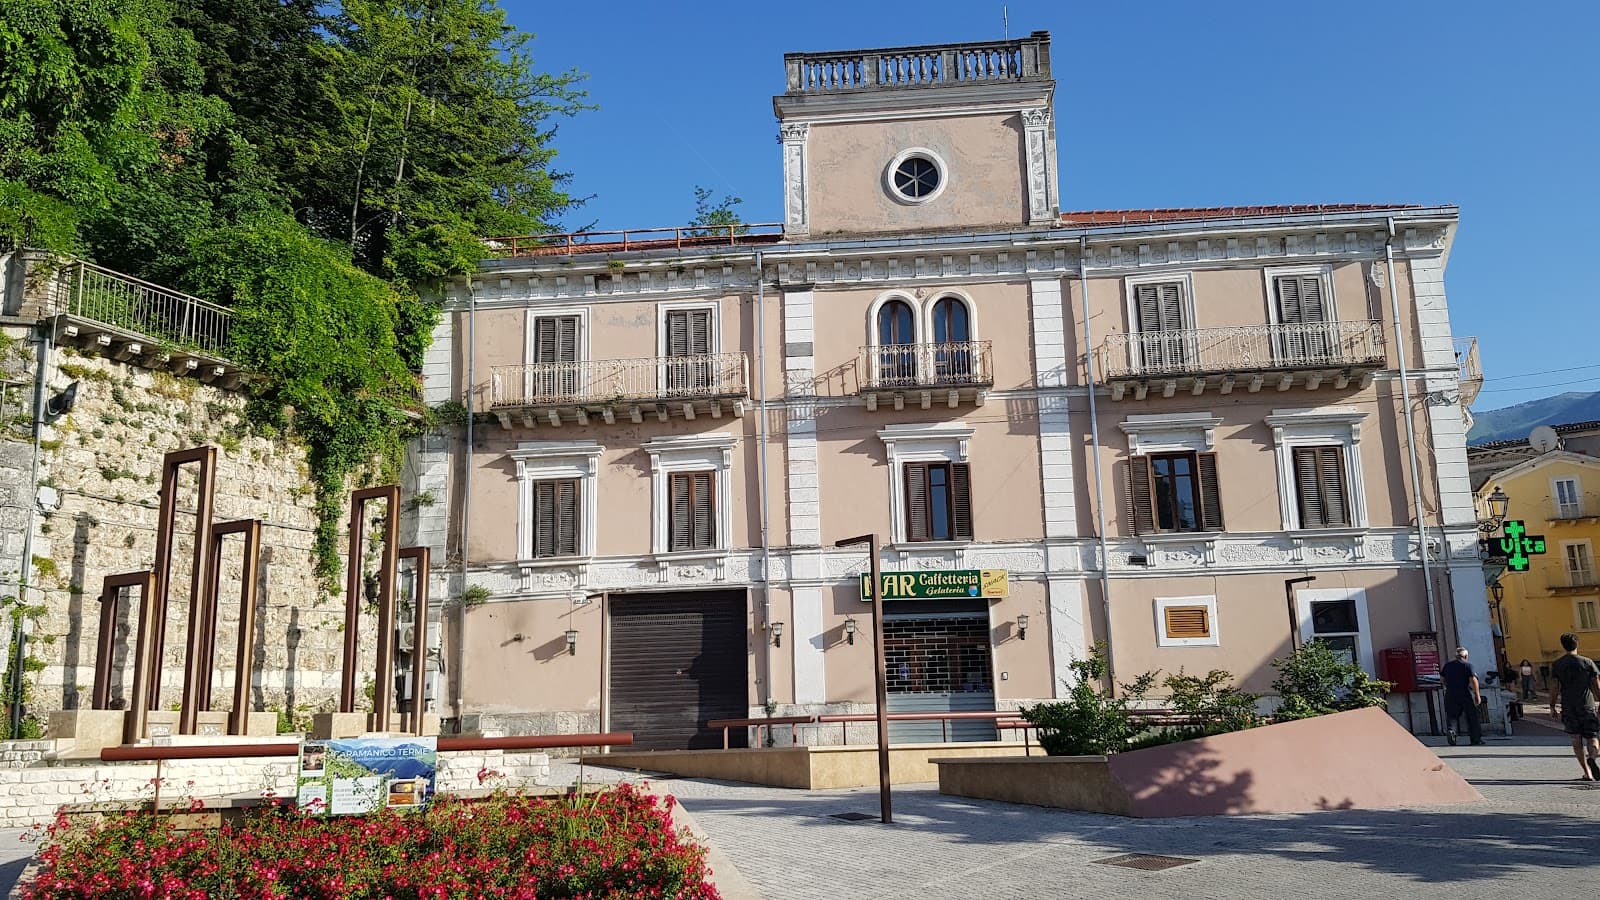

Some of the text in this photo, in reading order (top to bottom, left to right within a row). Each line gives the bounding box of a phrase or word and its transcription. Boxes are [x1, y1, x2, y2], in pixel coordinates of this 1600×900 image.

[919, 572, 979, 586] Caffetteria
[926, 586, 965, 596] Gelateria
[397, 747, 430, 757] TERME
